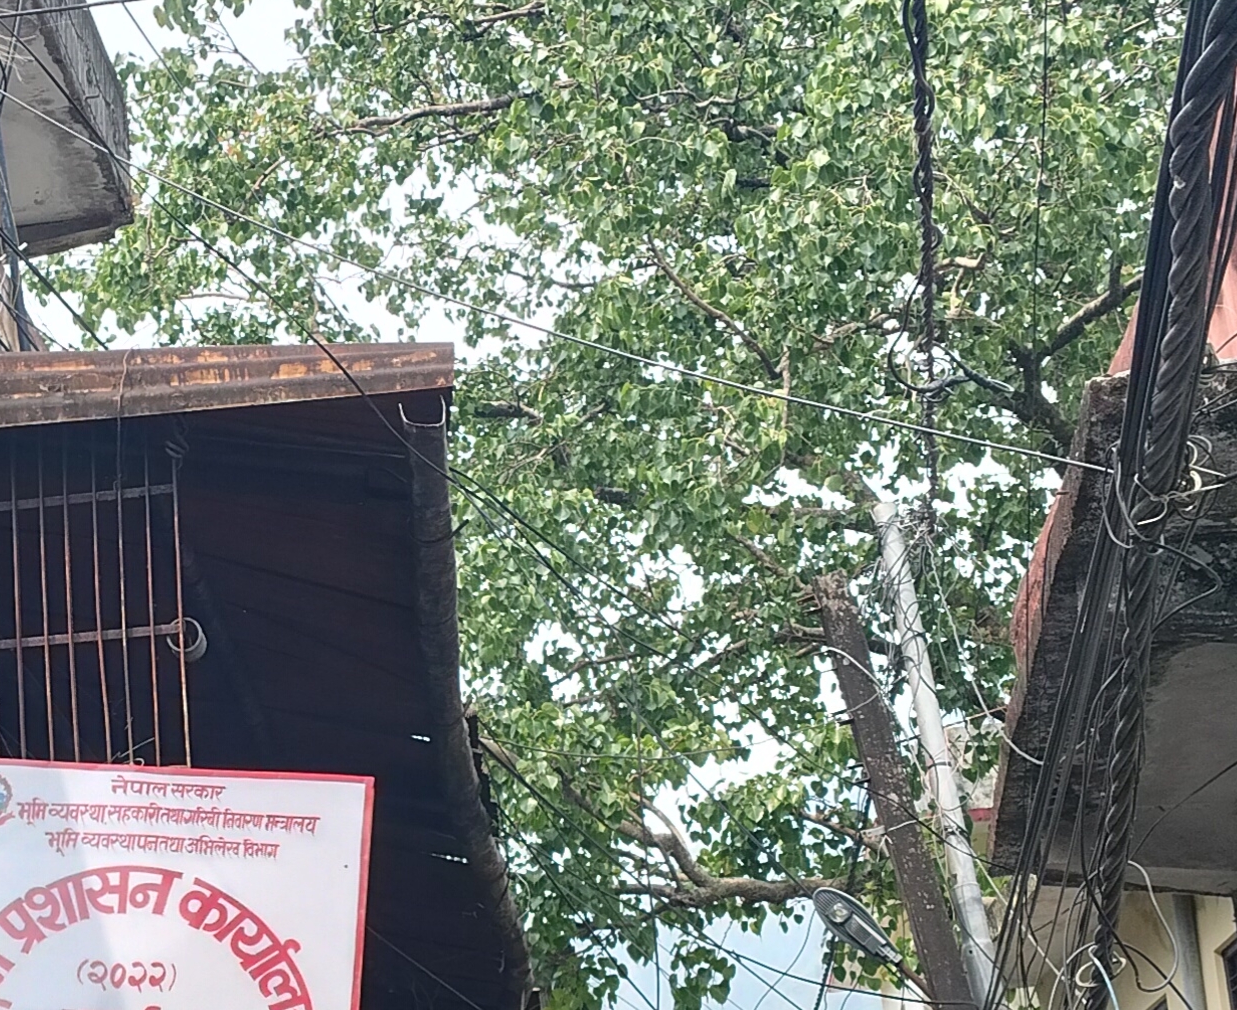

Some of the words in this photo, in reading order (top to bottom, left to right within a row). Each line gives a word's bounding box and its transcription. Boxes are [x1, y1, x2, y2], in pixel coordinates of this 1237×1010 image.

[111, 775, 168, 797] नेपाल
[171, 783, 226, 801] सरकार
[17, 797, 49, 826] भूमि
[108, 802, 160, 826] सहकारी
[265, 814, 321, 836] मन्त्रालय
[45, 828, 80, 857] भूमि
[185, 834, 242, 857] अभिलेख
[242, 838, 280, 860] विभाग
[76, 958, 178, 994] (२०२२)
